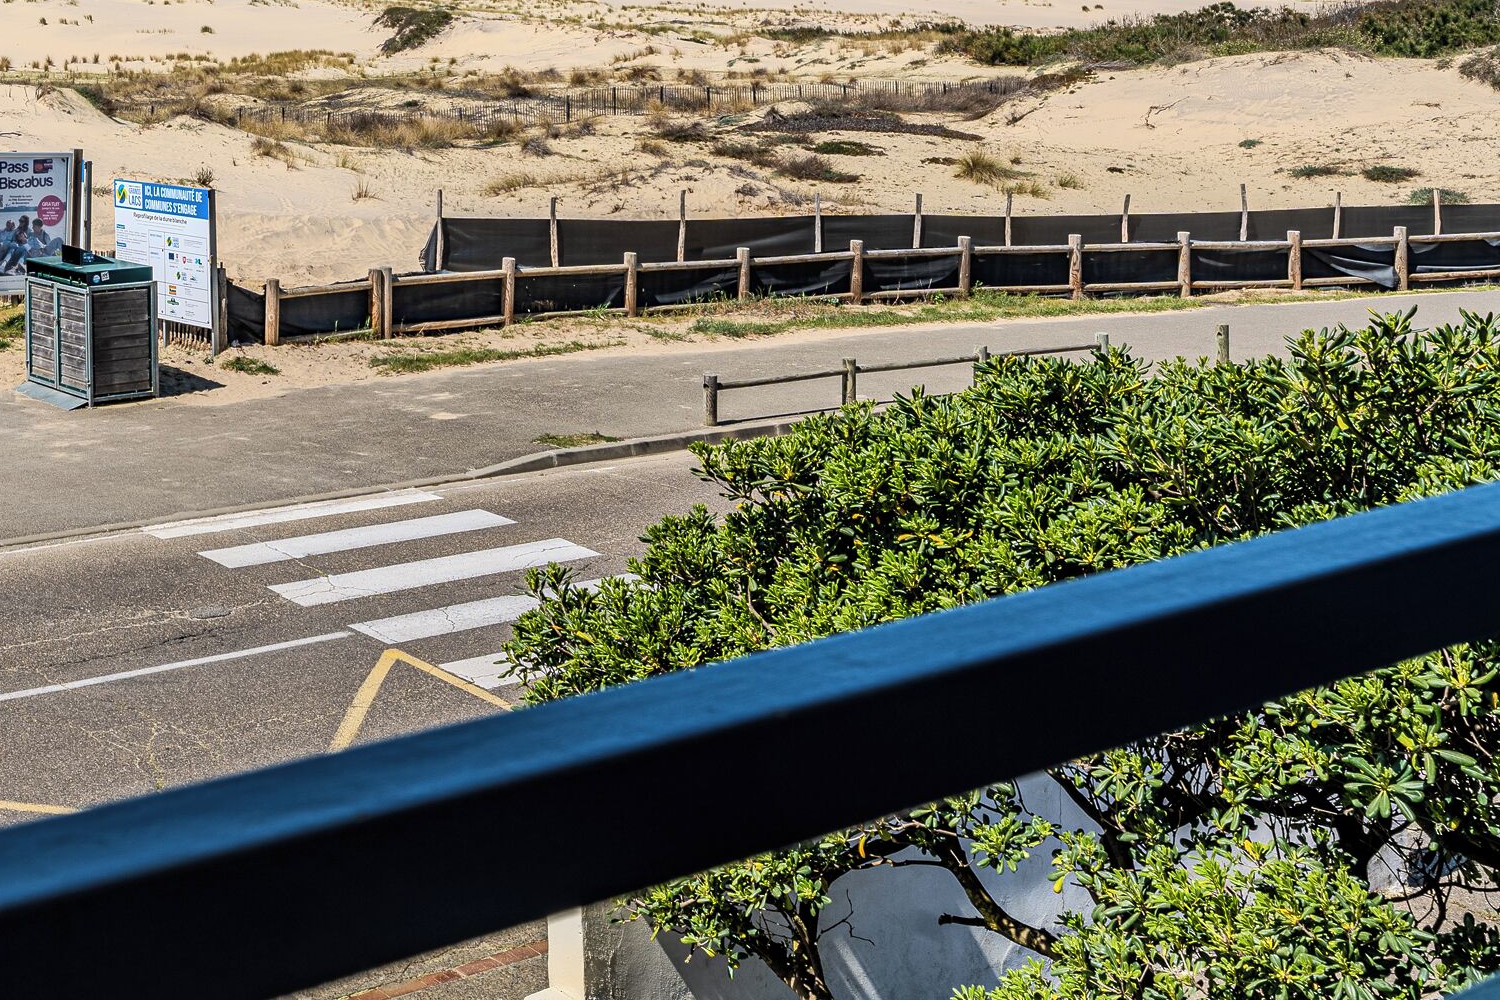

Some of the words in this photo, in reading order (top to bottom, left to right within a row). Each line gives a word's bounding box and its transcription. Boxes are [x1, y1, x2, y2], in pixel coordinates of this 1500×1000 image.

[0, 161, 29, 173] Pass
[0, 175, 54, 190] Biscabus
[153, 186, 160, 197] LA
[160, 187, 195, 202] COMMUNAUTÉ
[195, 191, 203, 203] DE
[145, 199, 173, 212] COMMUNES
[173, 202, 198, 216] S'ENGAGE
